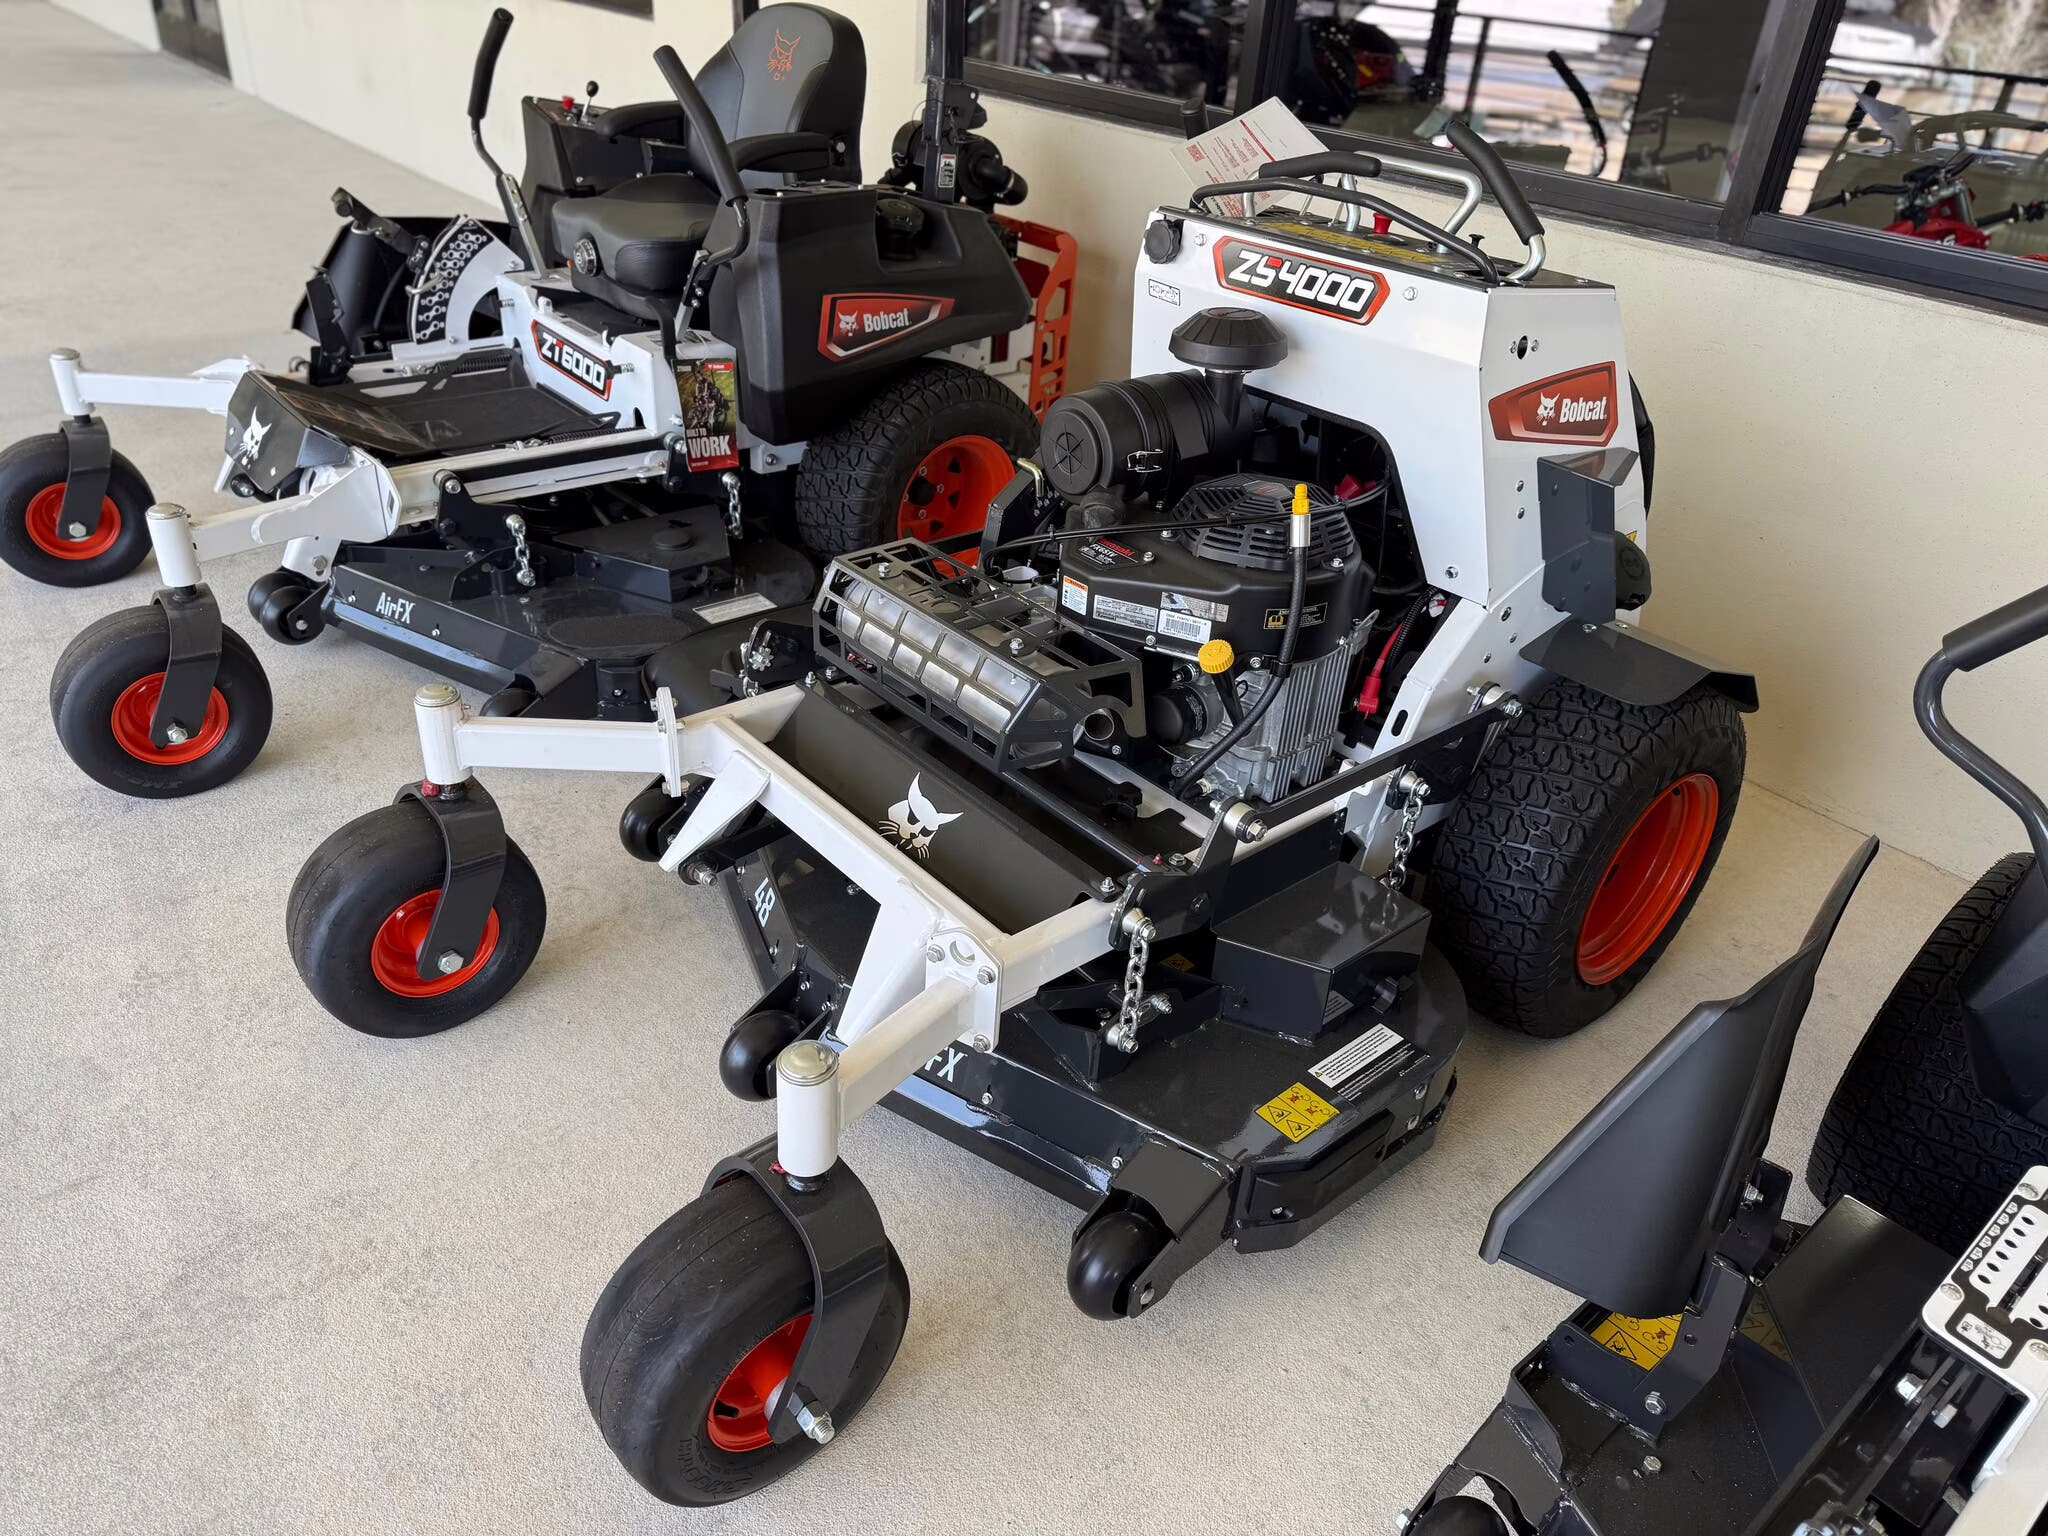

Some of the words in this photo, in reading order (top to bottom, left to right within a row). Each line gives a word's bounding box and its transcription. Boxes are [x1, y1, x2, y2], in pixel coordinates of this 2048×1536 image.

[1229, 250, 1375, 312] ZS4000
[863, 308, 909, 332] Bobcat
[541, 332, 605, 391] ZT6000
[1559, 397, 1607, 423] Bobcat
[688, 435, 731, 459] WORK
[375, 592, 414, 624] AirFX
[755, 877, 775, 927] 48
